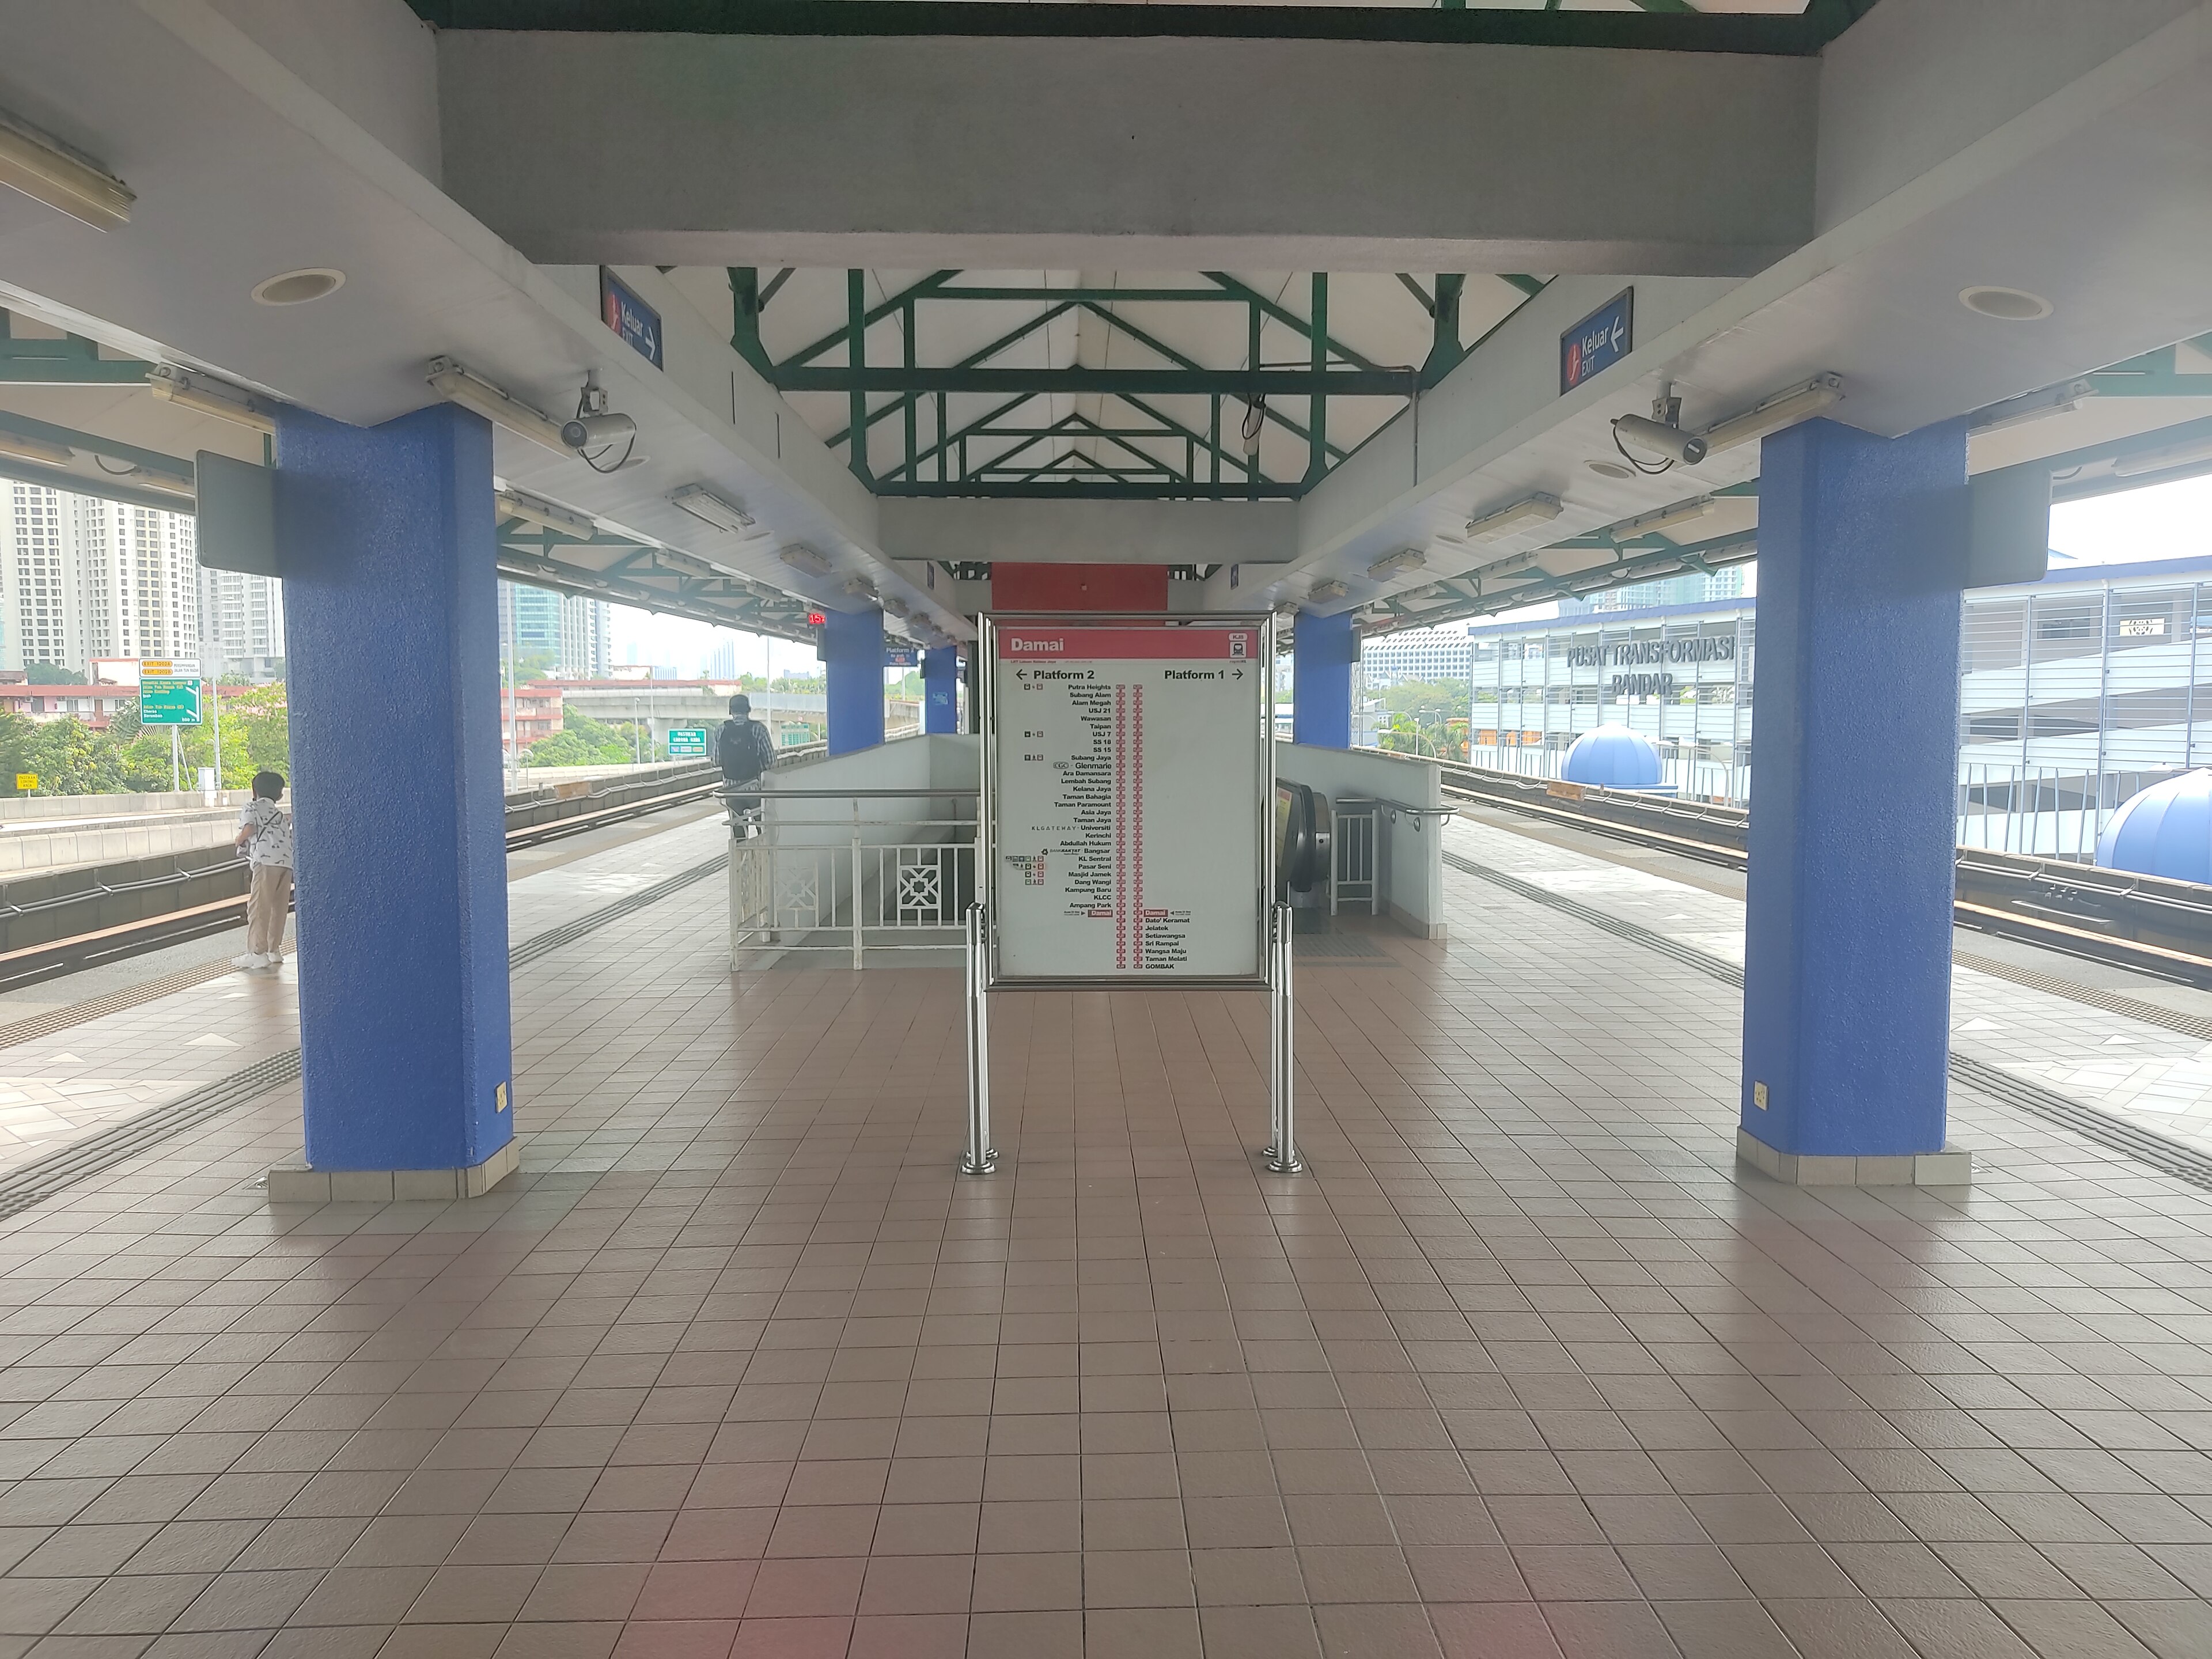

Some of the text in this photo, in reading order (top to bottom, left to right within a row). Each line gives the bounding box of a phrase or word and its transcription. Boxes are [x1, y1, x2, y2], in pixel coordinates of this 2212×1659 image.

[621, 302, 643, 337] Keluar
[623, 328, 634, 346] EXIT
[1582, 327, 1609, 357] Keluar
[1582, 355, 1595, 377] EXIT
[1010, 638, 1065, 652] Damai
[1567, 636, 1735, 668] PUSAT TRANSFORMASI
[1033, 670, 1094, 680] Platform 2
[1165, 670, 1224, 679] Platform 1
[1612, 673, 1673, 696] BANDAR
